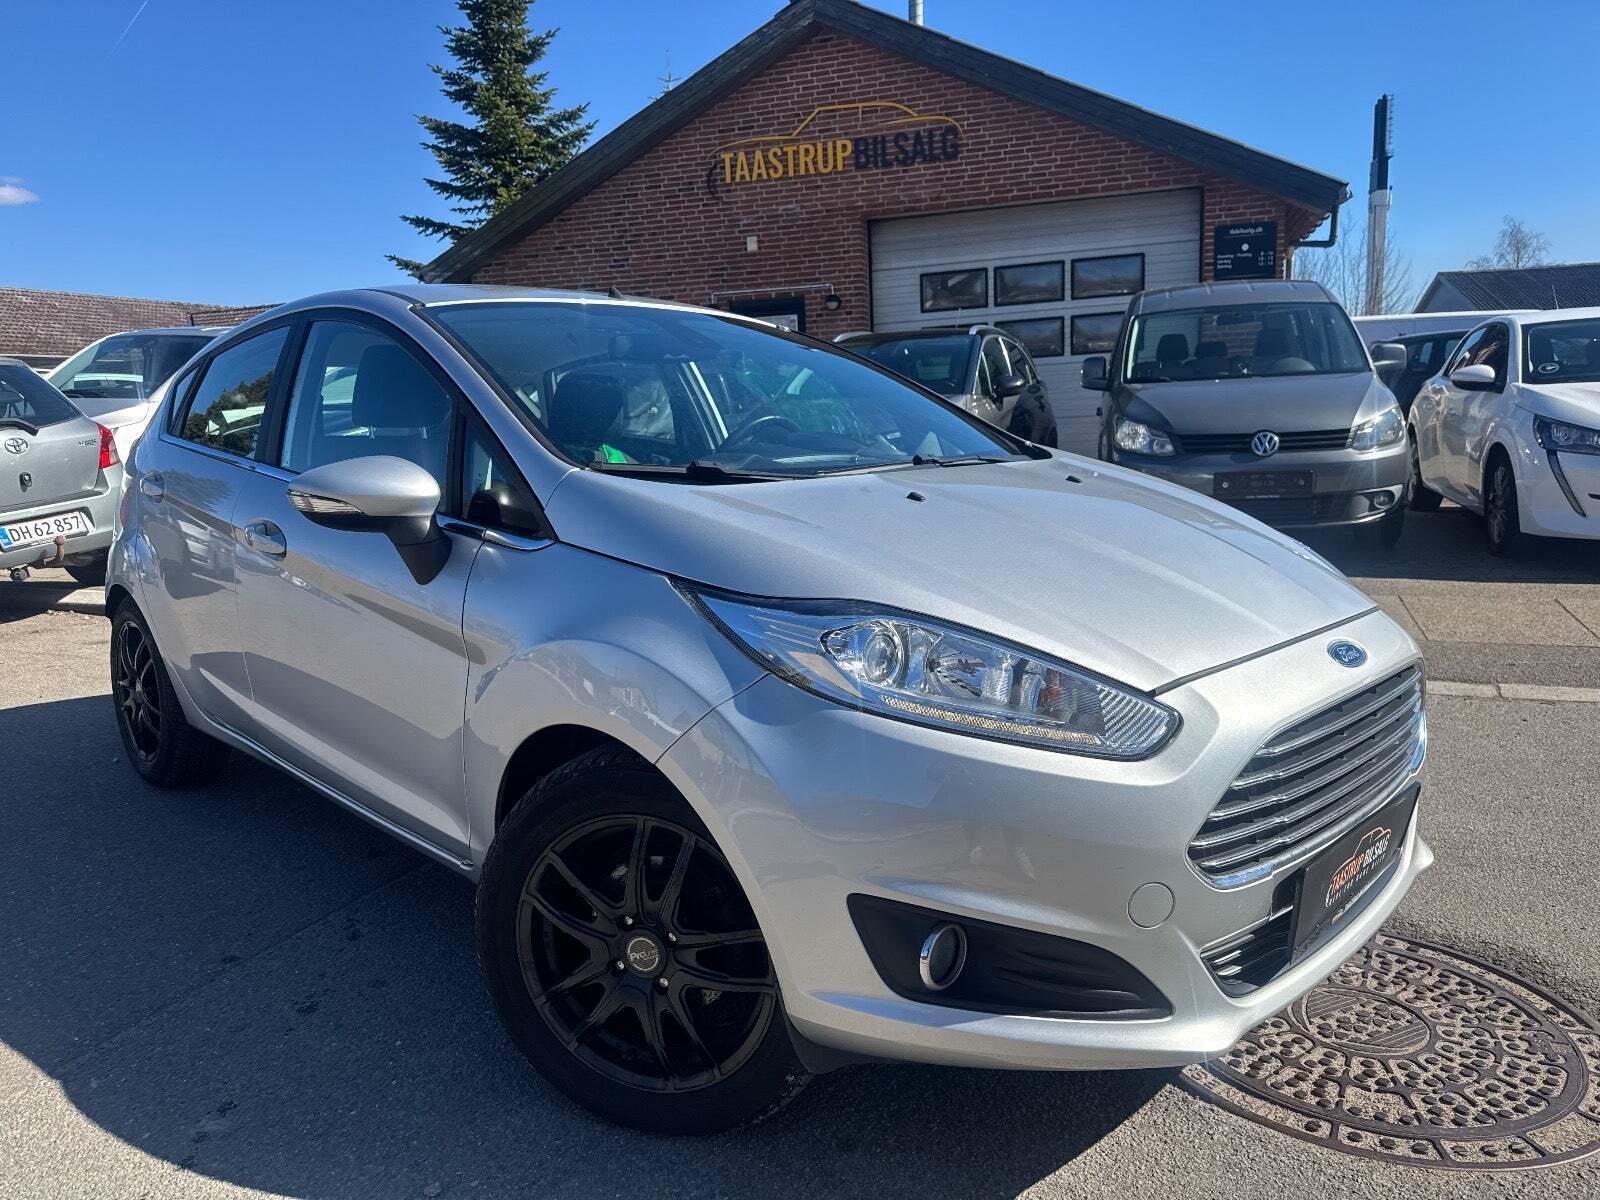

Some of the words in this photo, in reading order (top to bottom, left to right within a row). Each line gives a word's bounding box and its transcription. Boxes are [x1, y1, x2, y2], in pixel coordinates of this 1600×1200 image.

[8, 525, 33, 542] DH
[34, 521, 54, 537] 62
[54, 515, 80, 533] 857
